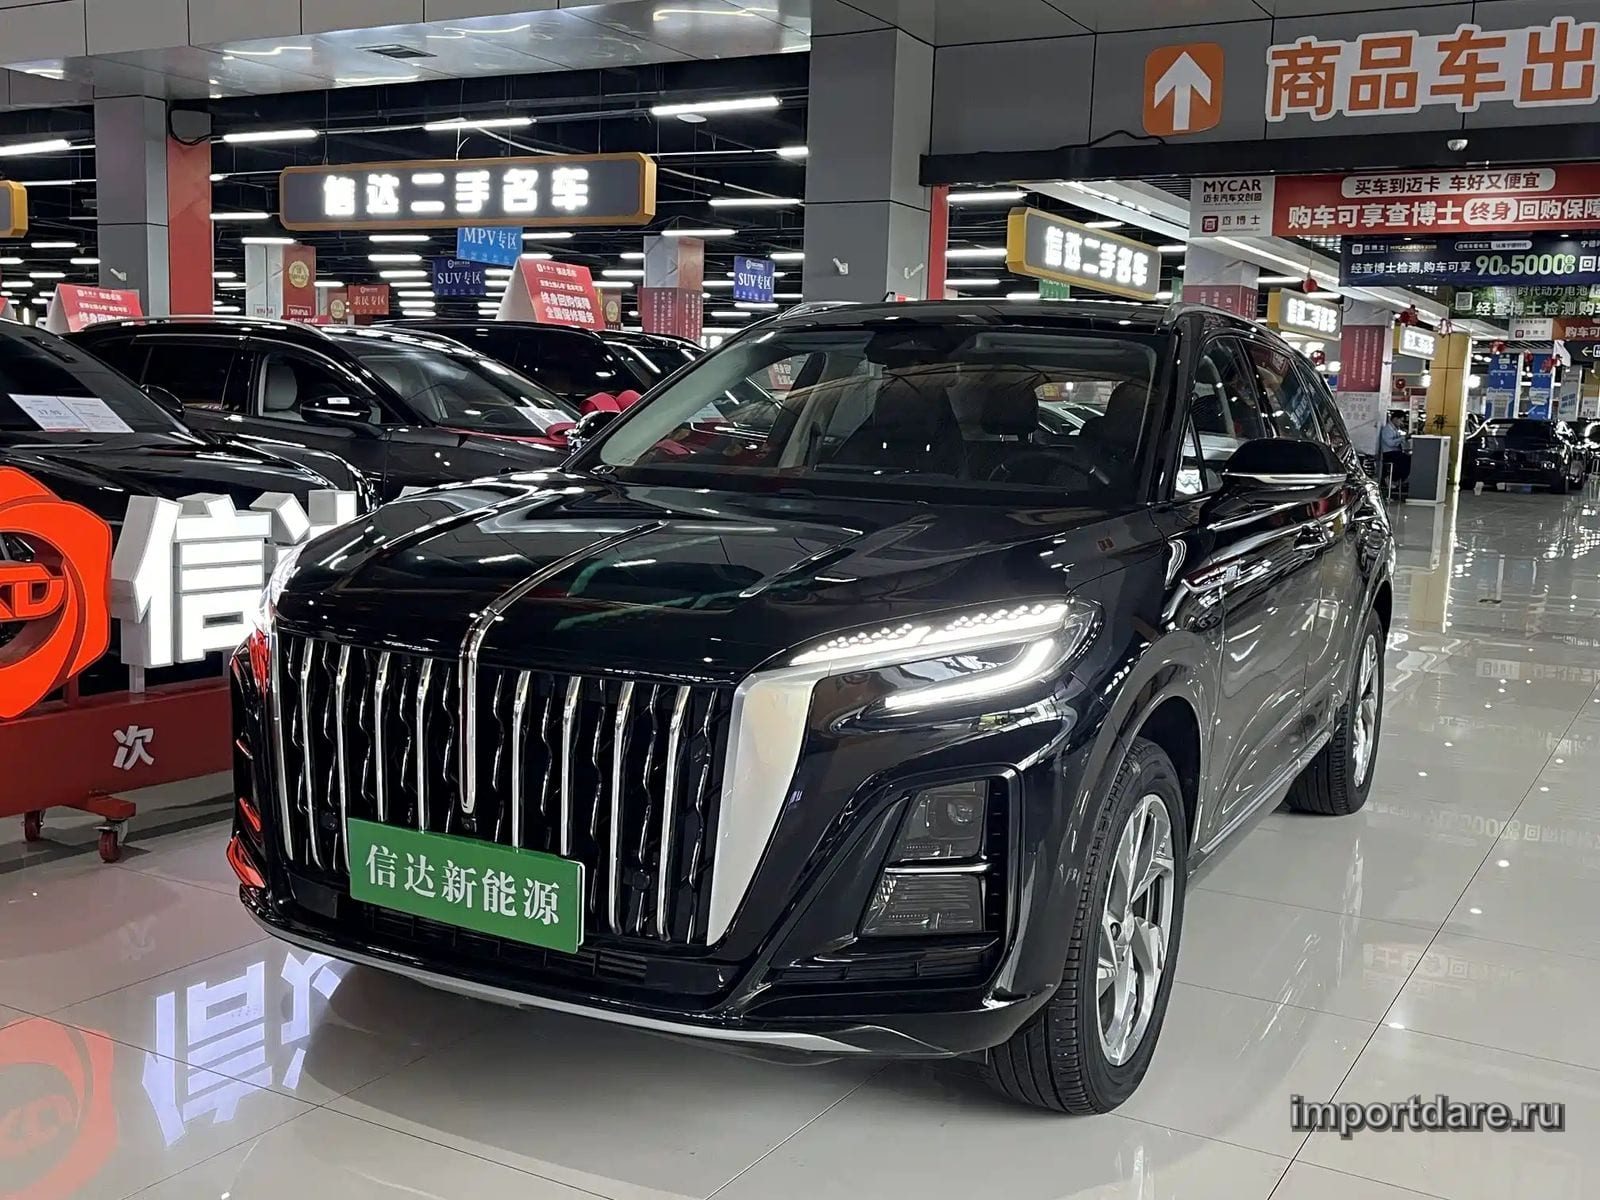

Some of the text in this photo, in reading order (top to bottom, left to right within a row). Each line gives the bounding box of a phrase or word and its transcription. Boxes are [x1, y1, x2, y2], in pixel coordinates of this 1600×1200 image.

[1268, 19, 1598, 119] 商品车出
[324, 167, 590, 216] 信达二手名车
[1203, 179, 1262, 193] MYCAR
[1354, 172, 1540, 195] 买车到迈卡 车好又便宜
[463, 227, 518, 249] MPV专区
[1045, 226, 1149, 286] 信达二手名车
[437, 271, 482, 285] SUV专区
[738, 272, 772, 290] SUV专区
[112, 724, 154, 771] 次
[365, 843, 560, 926] 信达新能源
